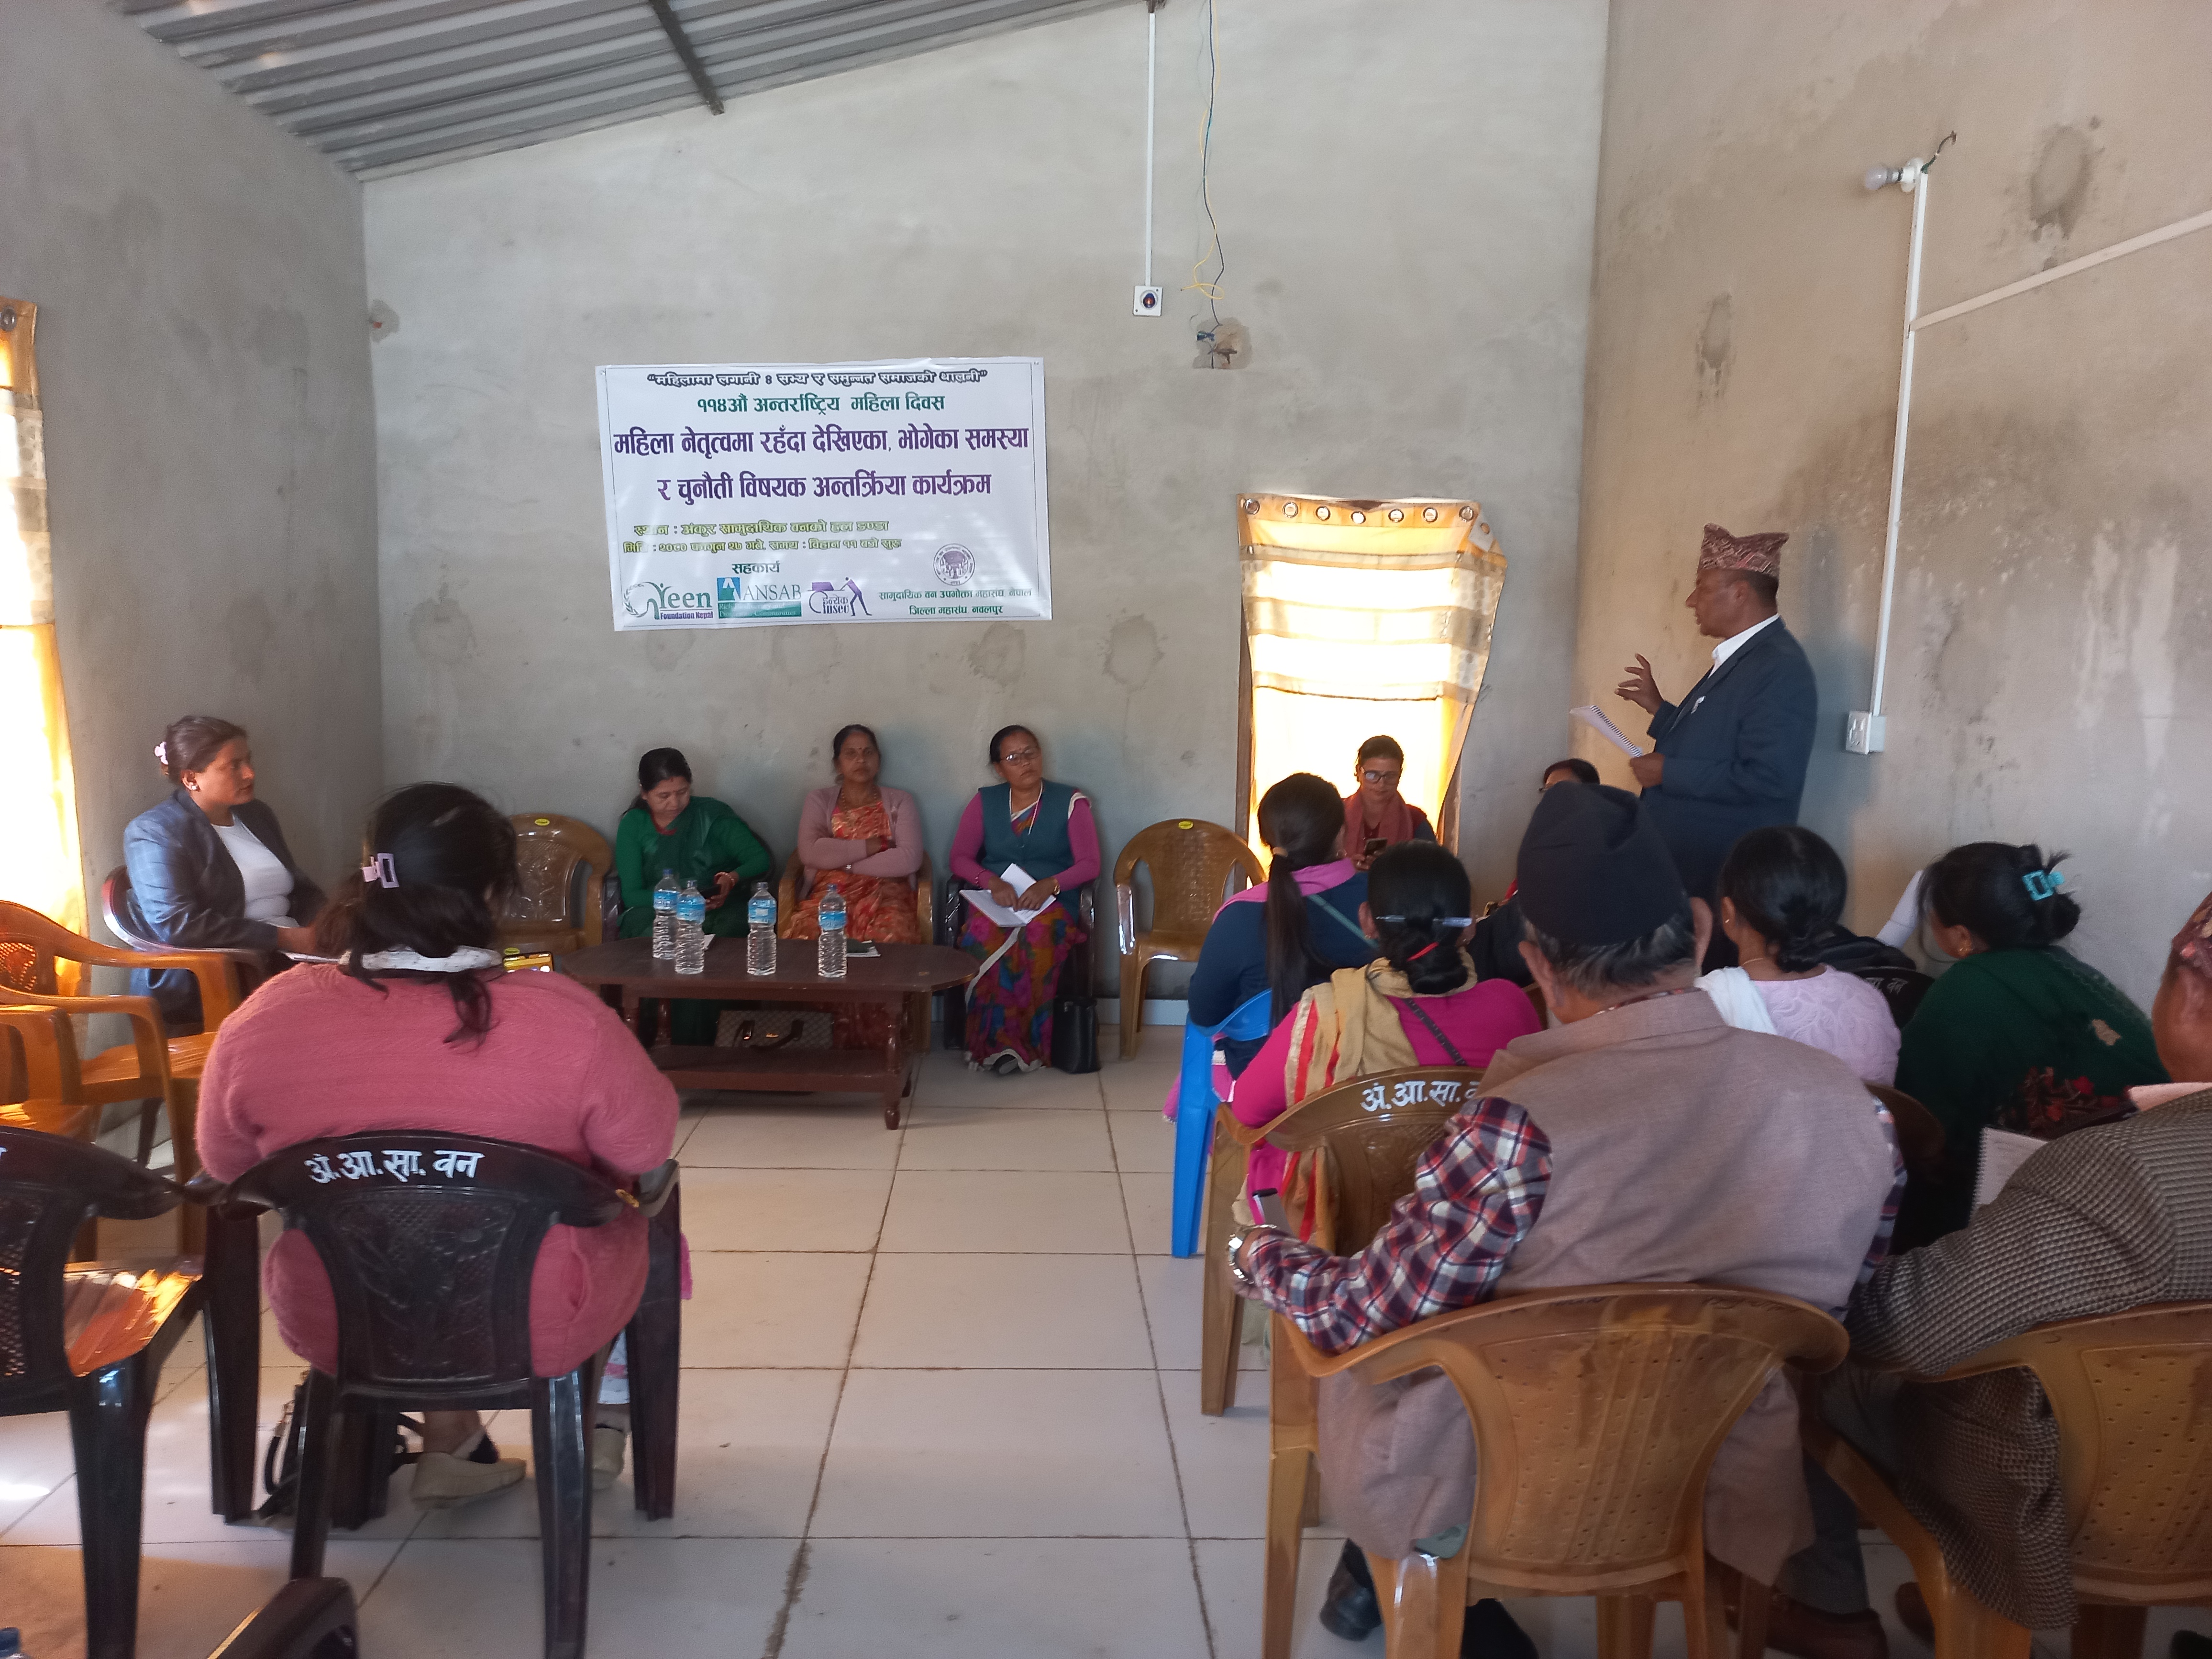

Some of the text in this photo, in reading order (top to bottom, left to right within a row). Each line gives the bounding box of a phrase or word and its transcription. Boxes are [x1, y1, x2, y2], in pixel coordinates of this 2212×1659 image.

[716, 371, 761, 386] लगानी
[776, 373, 809, 386] सभ्य
[812, 372, 825, 386] र
[827, 372, 876, 387] समुन्नत
[878, 370, 937, 385] समाजको
[851, 392, 900, 411] महिला
[905, 391, 945, 411] दिवस
[613, 423, 1029, 459] महिला नेतृत्वमा रहँदा देखिएका, भोगेका समस्या
[657, 479, 671, 500] र
[676, 471, 734, 505] चुनौती
[739, 471, 807, 498] विषयक
[912, 469, 991, 496] कार्यक्रम
[681, 522, 717, 537] अंकुर
[719, 520, 787, 536] सामुदायिक
[790, 519, 828, 532] वनको
[658, 543, 687, 553] २०८०
[769, 540, 799, 550] समय
[732, 560, 780, 574] सहकार्य
[743, 584, 802, 601] ANSAB
[879, 589, 922, 601] सामुदायिक
[909, 605, 936, 615] जिल्ला
[972, 605, 1004, 615] नवलपुर
[432, 1150, 485, 1178] वन
